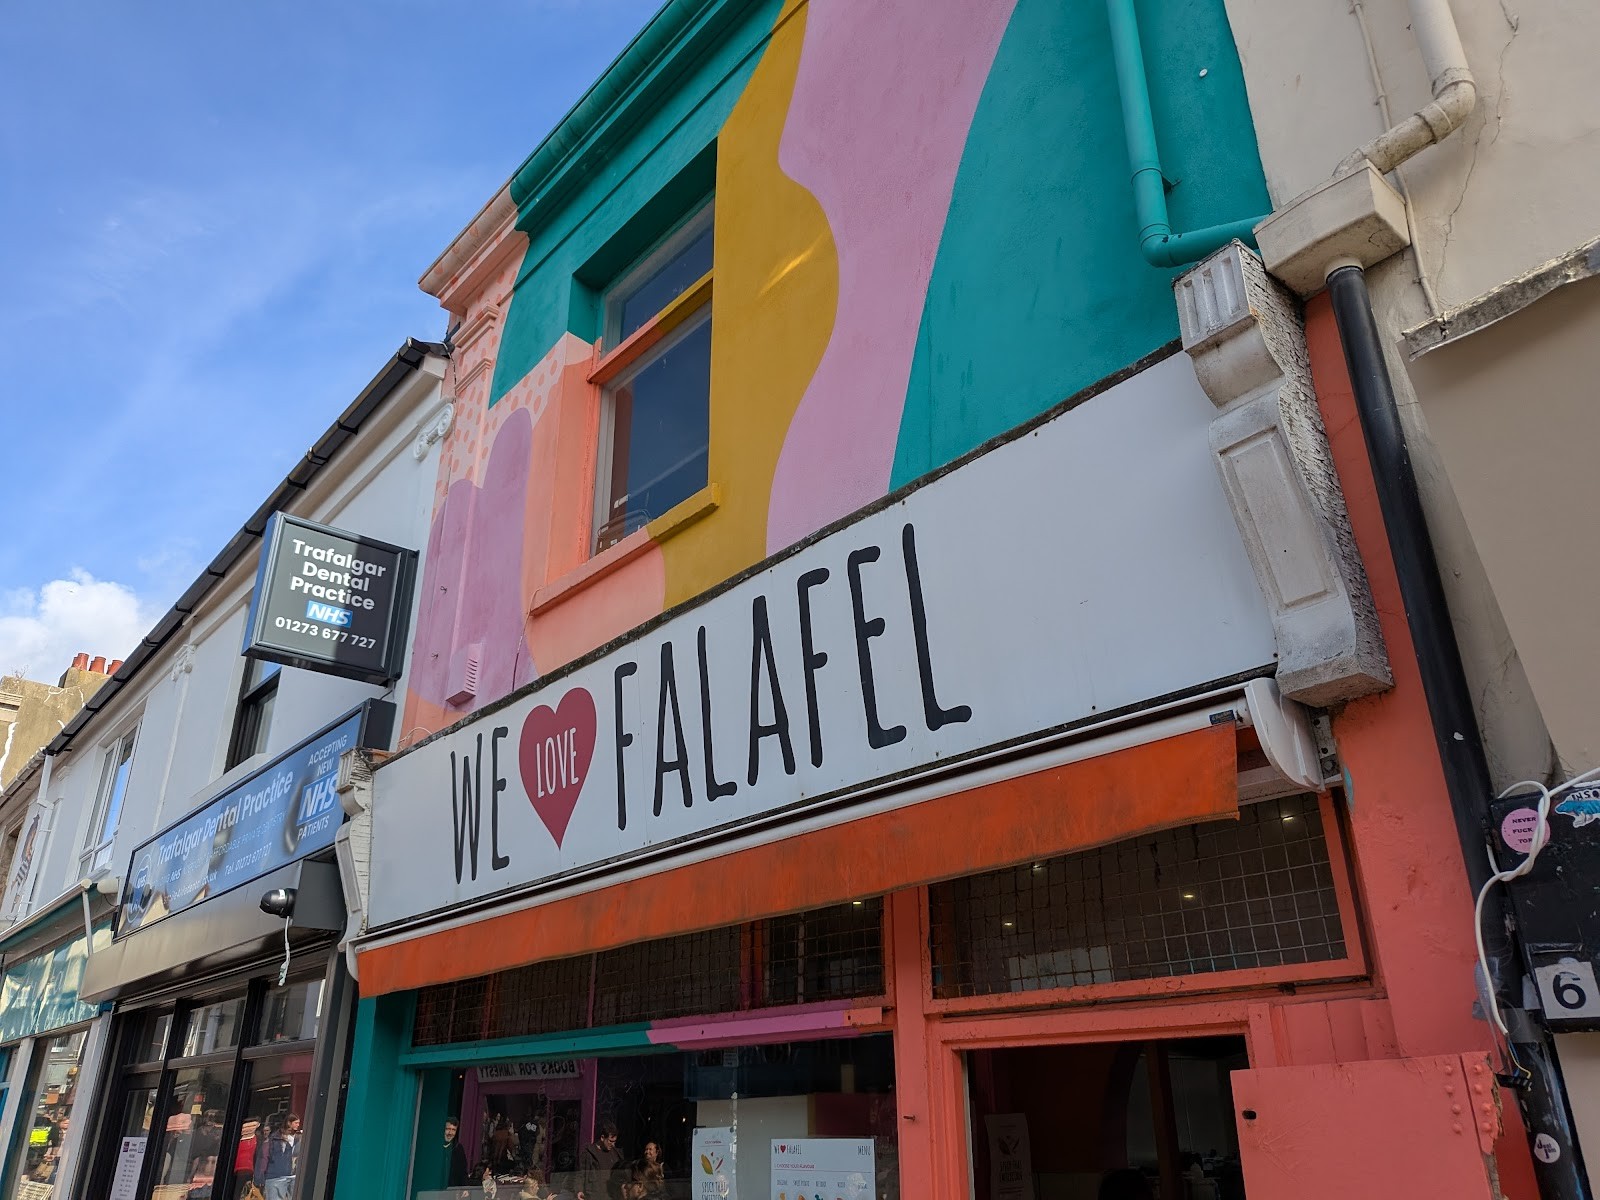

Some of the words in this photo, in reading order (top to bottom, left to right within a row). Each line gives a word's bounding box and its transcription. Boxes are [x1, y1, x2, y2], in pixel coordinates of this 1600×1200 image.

[293, 539, 387, 577] Trafalgar
[290, 576, 375, 610] Practice
[302, 561, 370, 592] Dental
[308, 603, 351, 625] NHS
[275, 616, 319, 637] 01273
[322, 628, 349, 643] 677
[351, 634, 377, 650] 727
[450, 726, 509, 884] WE
[535, 727, 579, 798] LOVE
[613, 523, 973, 831] FALAFEL
[308, 734, 348, 767] ACCEPTING
[316, 757, 335, 776] NEW
[299, 773, 338, 820] NHS
[158, 827, 204, 866] Trafalgar
[202, 798, 241, 841] Dental
[241, 771, 294, 821] Practice
[297, 815, 330, 841] PATIENTS
[1552, 971, 1587, 1010] 6
